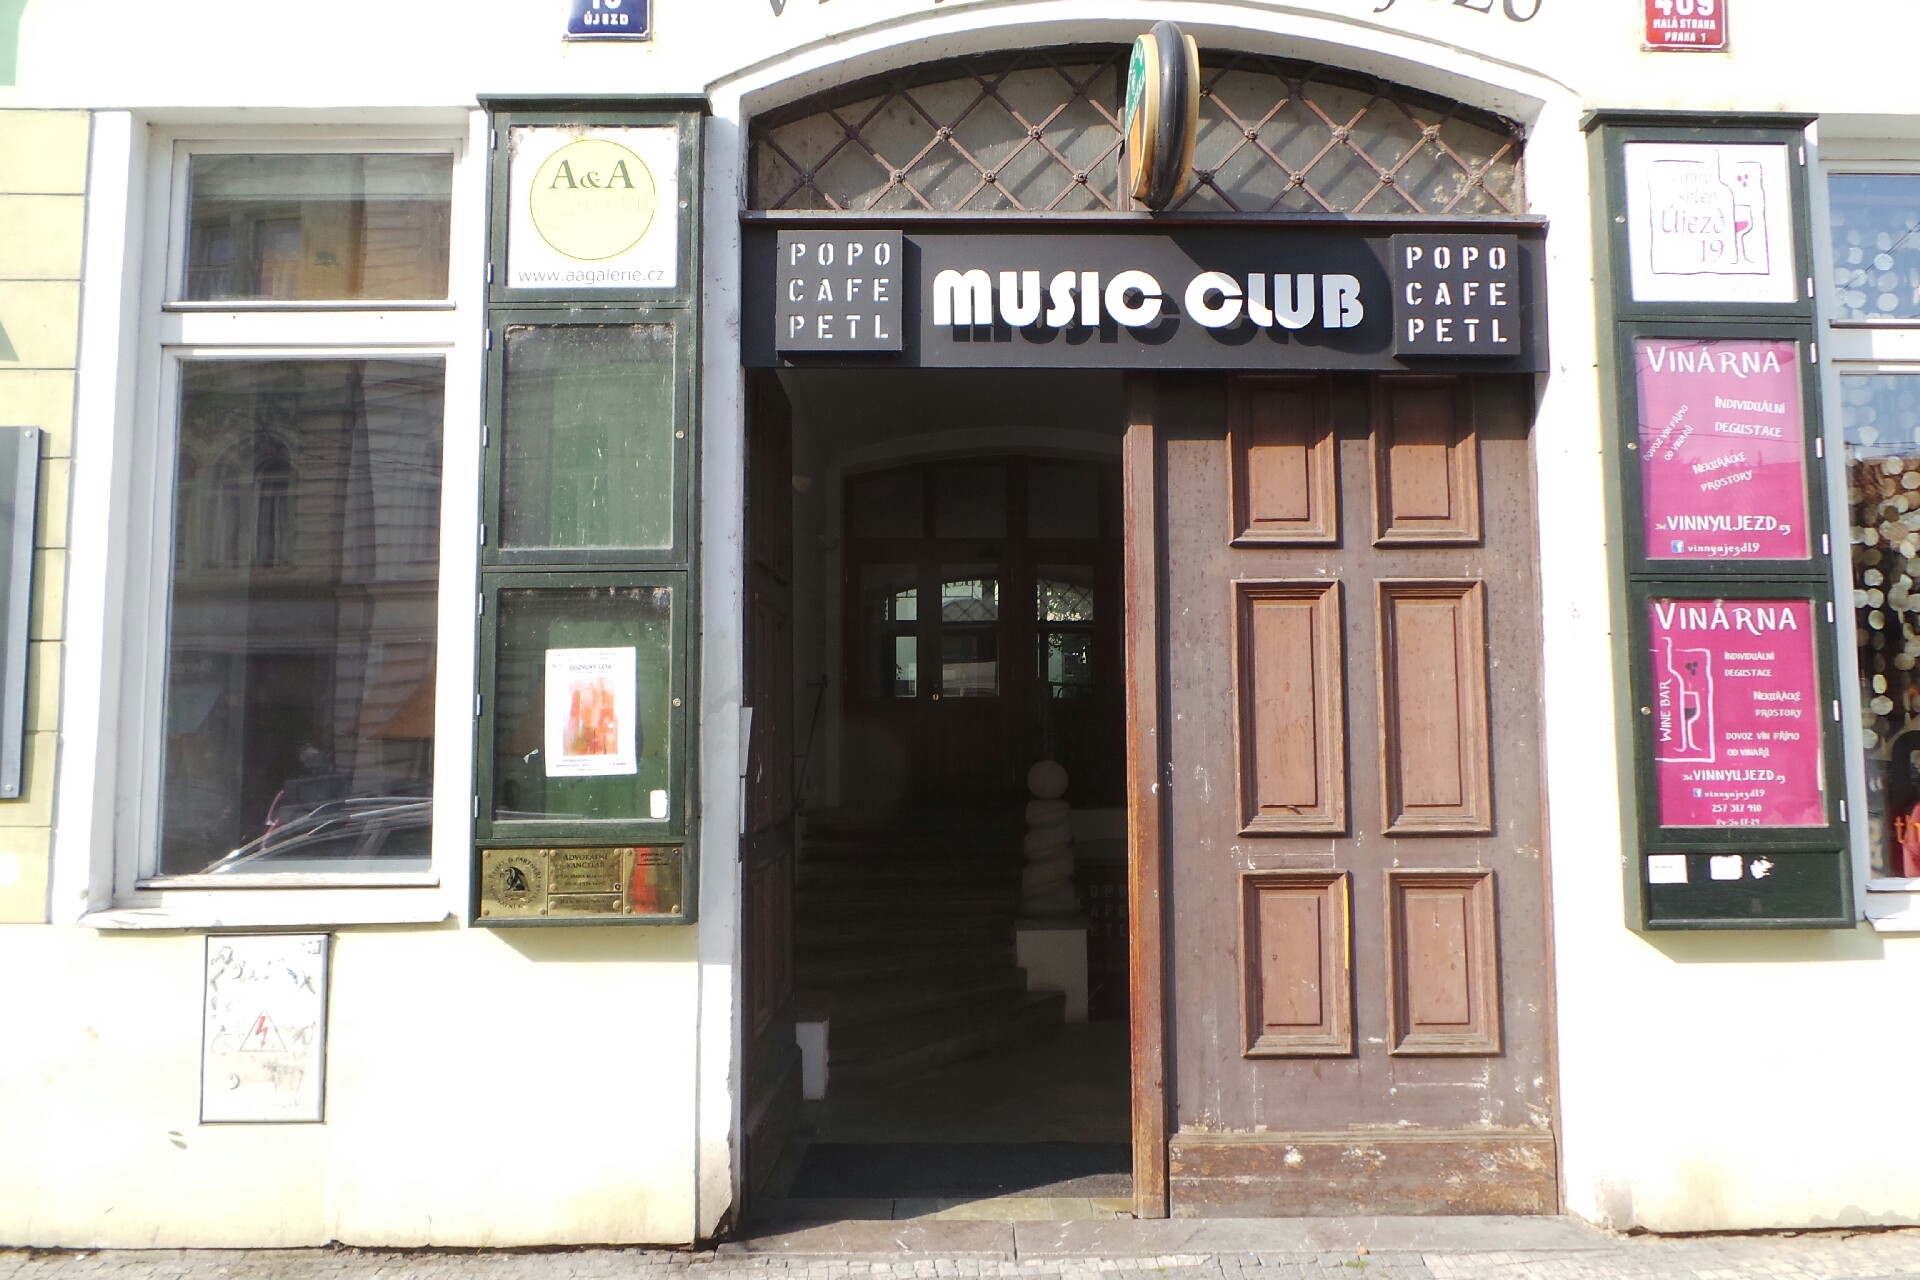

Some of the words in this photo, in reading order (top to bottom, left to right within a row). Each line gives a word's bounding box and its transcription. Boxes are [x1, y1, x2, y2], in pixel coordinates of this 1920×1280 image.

[583, 10, 629, 25] ÚJEZD
[1653, 16, 1679, 29] MALÁ
[1679, 19, 1716, 30] STRANA
[1664, 31, 1696, 42] PRAHA
[1661, 204, 1726, 238] Újezd
[789, 242, 891, 266] POPO
[1406, 246, 1506, 270] POPO
[1699, 239, 1725, 263] 19
[518, 267, 665, 286] www.aagalerie.cz
[788, 278, 890, 301] CAFE
[932, 268, 1163, 328] MUSIC
[1184, 271, 1364, 329] CLUB
[1405, 282, 1507, 306] CAFE
[788, 314, 889, 339] PETL
[1407, 318, 1508, 343] PETL
[1646, 346, 1781, 379] VINÁRNA
[1714, 421, 1783, 437] DEGUSTACE
[1700, 469, 1753, 492] PROSTORY
[1654, 600, 1798, 636] VINÁRNA
[1724, 669, 1772, 677] DEGUSTACE
[1659, 678, 1672, 707] BAR
[1755, 709, 1802, 718] PROSTORY
[1659, 710, 1672, 742] WINE
[1725, 732, 1753, 740] DOVOZ
[1712, 804, 1727, 813] 257
